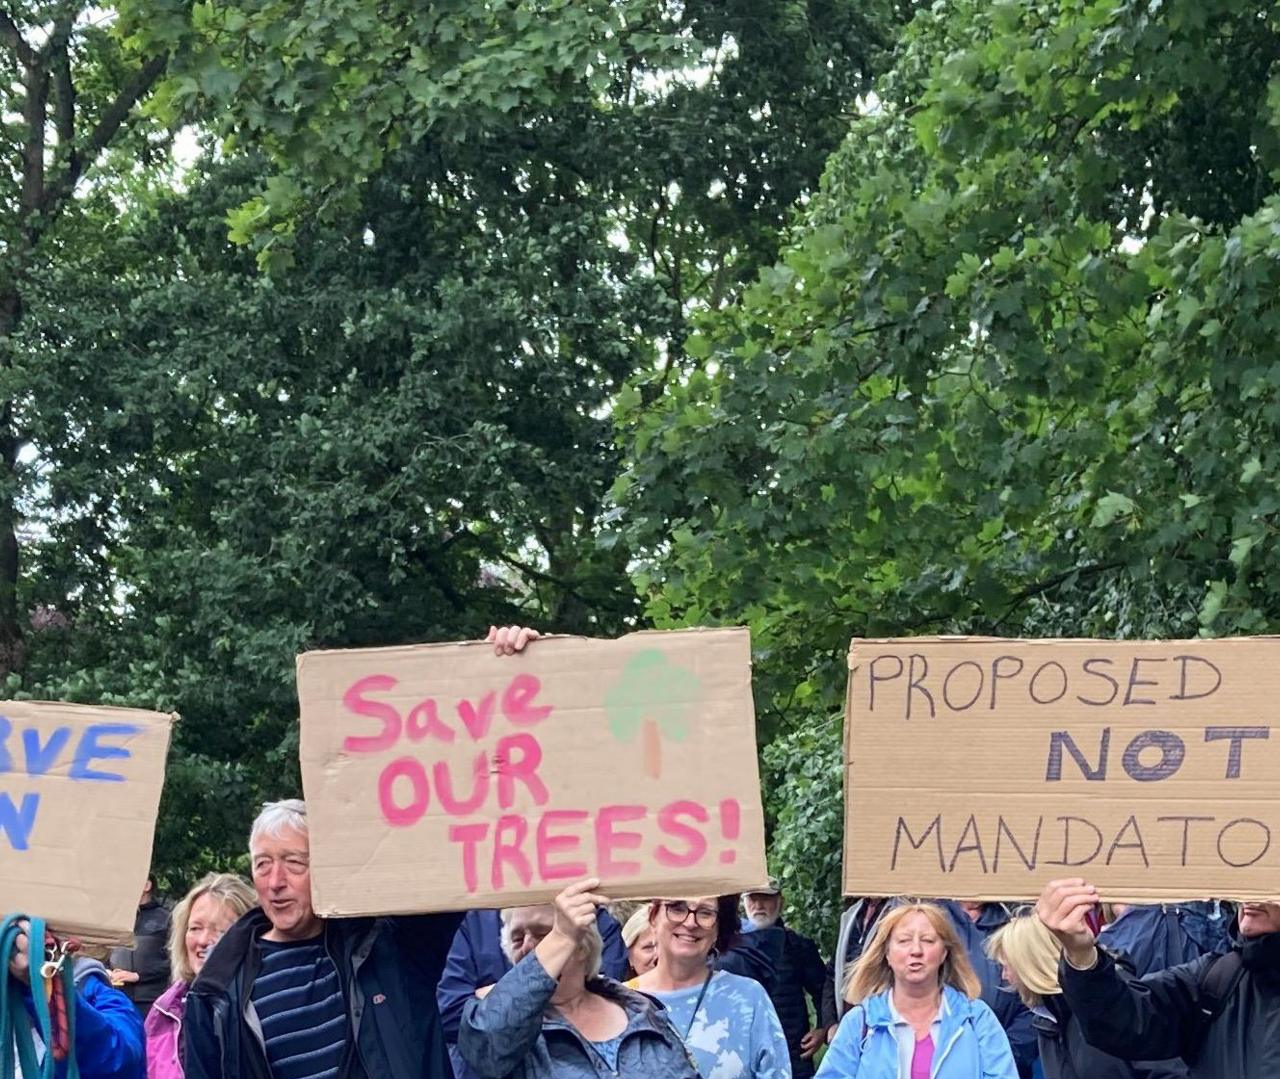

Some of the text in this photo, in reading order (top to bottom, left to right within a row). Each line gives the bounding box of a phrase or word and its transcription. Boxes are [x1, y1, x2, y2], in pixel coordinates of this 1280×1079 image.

[341, 672, 555, 754] Save
[868, 654, 1222, 720] PROPOSED
[377, 732, 550, 828] OUR
[1045, 725, 1270, 783] NOT
[448, 798, 741, 894] TREES!
